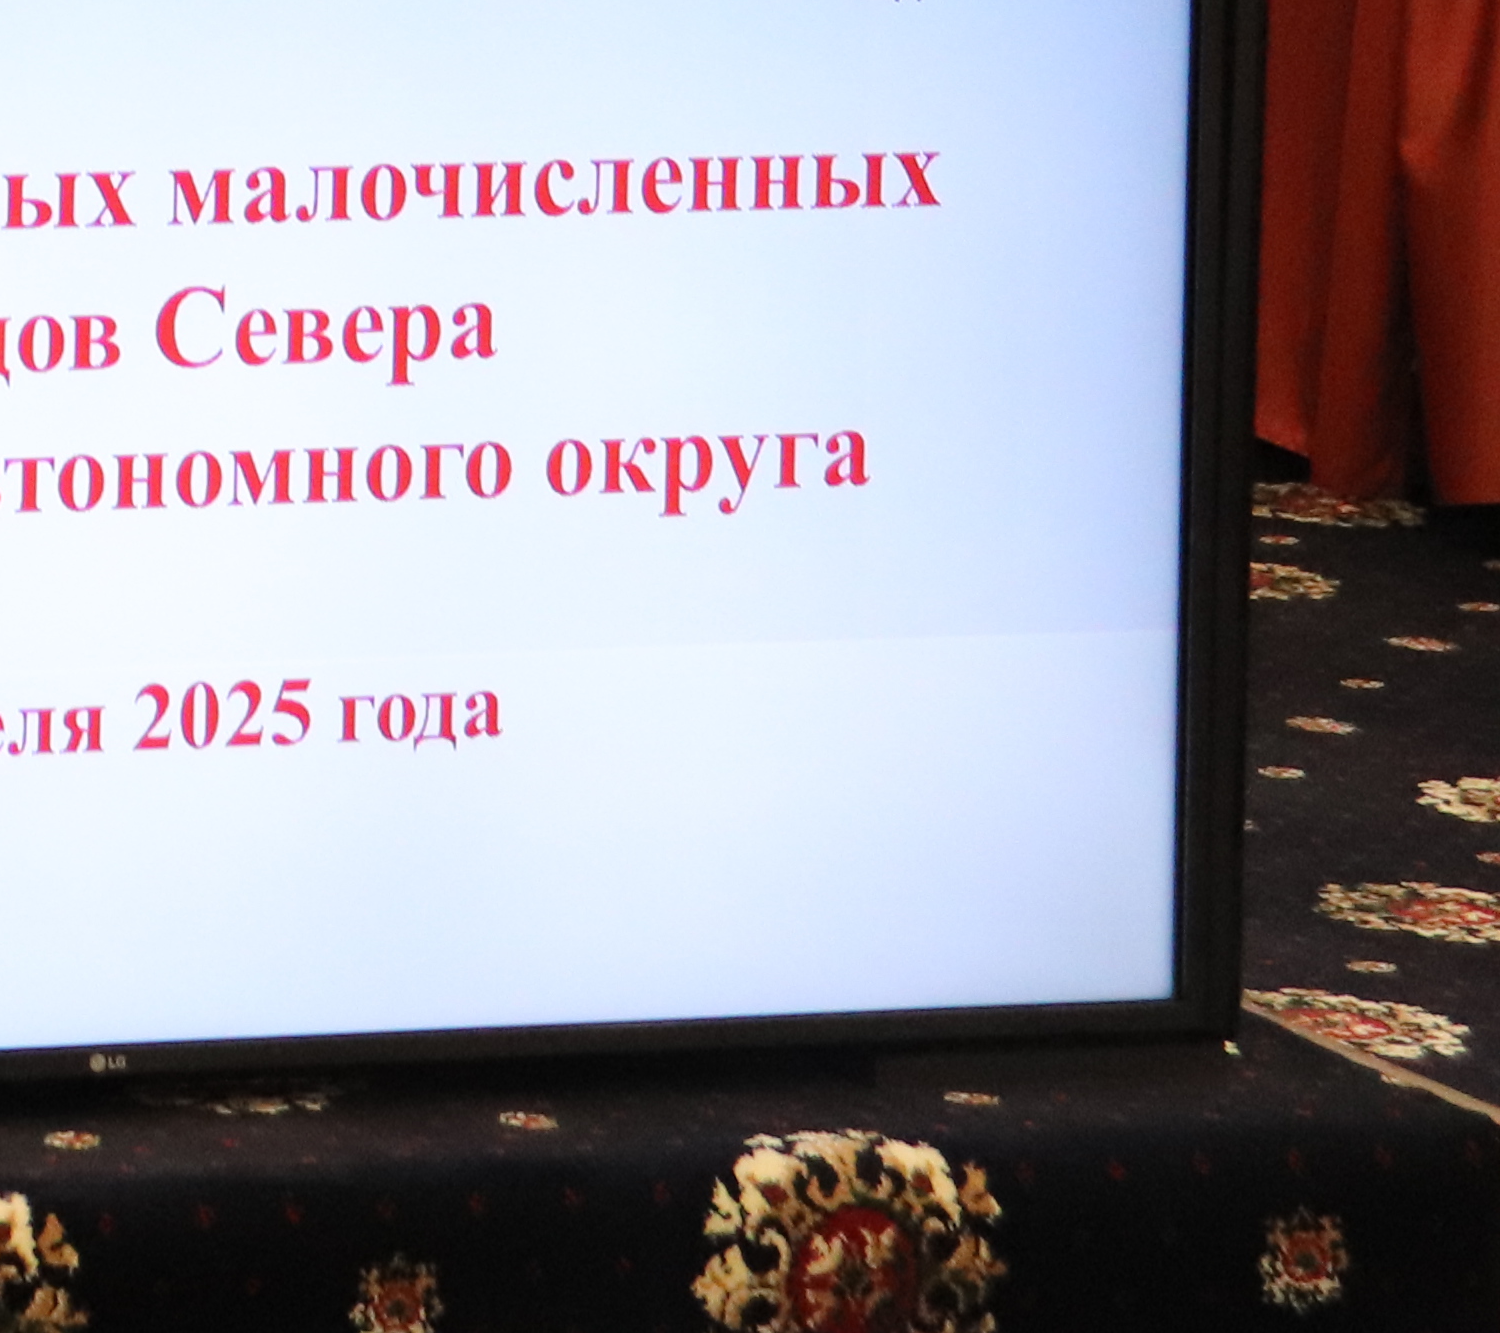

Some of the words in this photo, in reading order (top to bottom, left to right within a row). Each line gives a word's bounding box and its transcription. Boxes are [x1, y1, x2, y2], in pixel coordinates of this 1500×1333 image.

[170, 150, 940, 227] малочисленных
[157, 287, 494, 385] Севера
[548, 431, 868, 516] округа
[138, 680, 310, 750] 2025
[341, 689, 502, 750] года
[107, 1055, 126, 1070] LG
